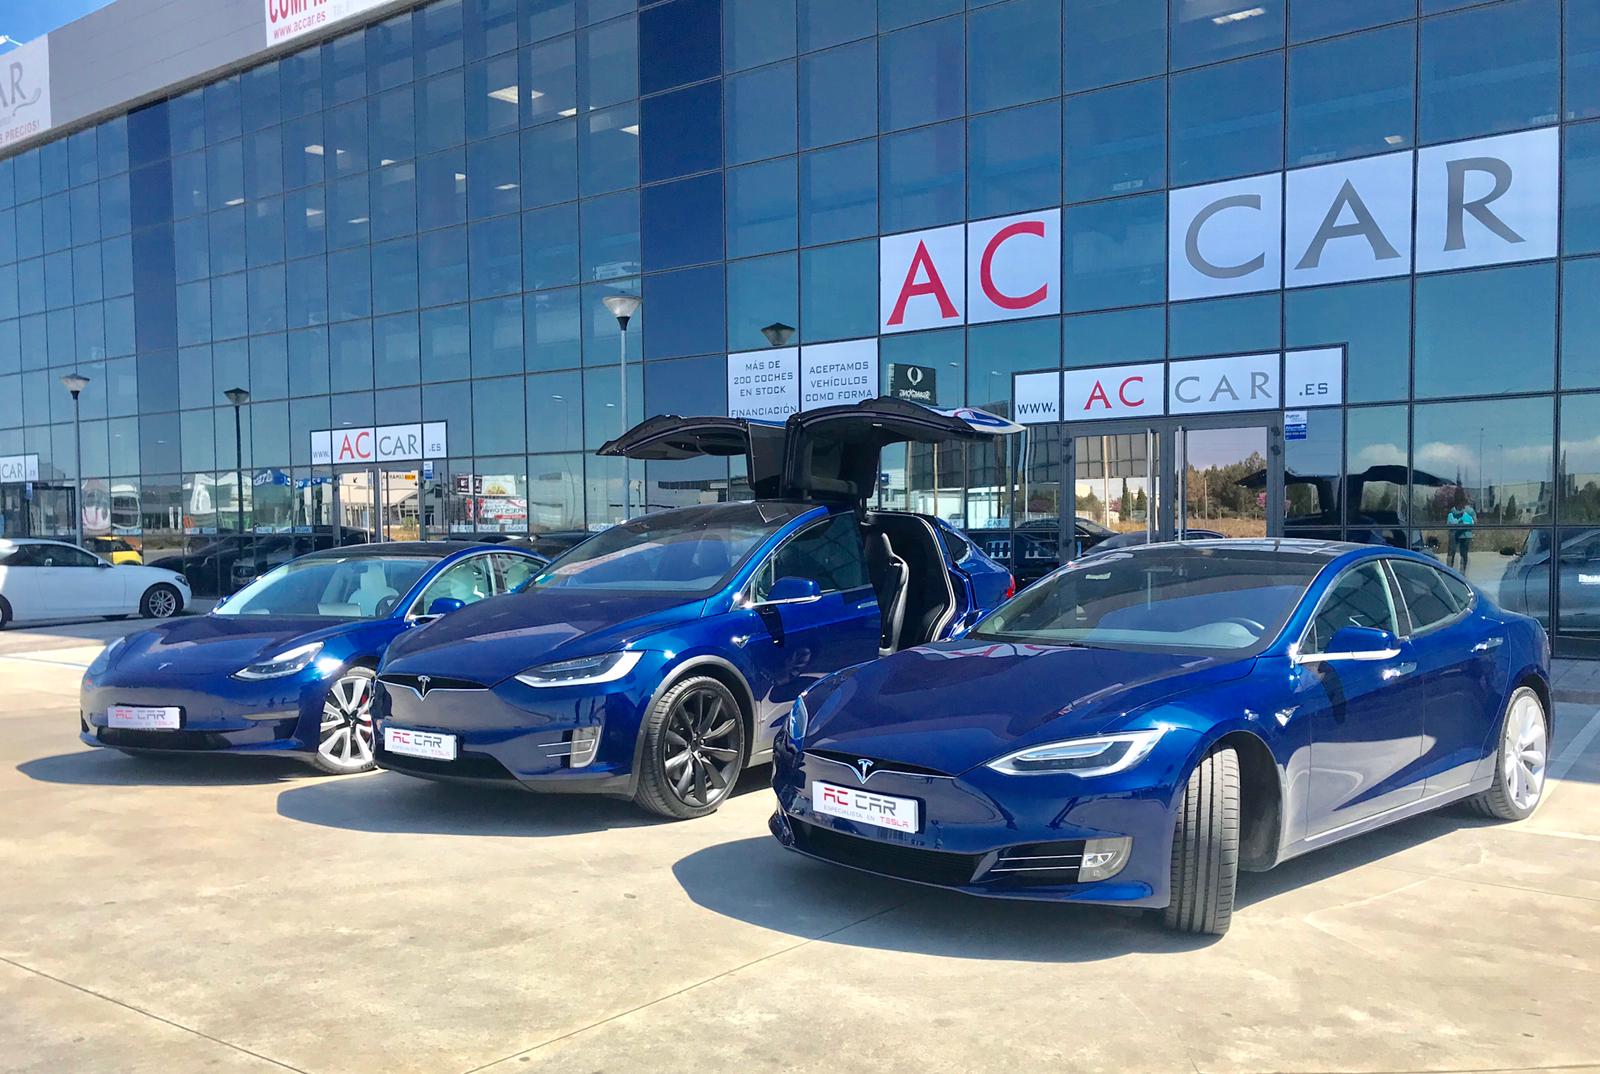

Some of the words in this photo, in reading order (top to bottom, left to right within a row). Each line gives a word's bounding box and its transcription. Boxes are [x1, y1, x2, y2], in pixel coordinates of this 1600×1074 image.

[273, 11, 327, 39] www.accar.es
[886, 221, 1048, 326] AC
[1184, 157, 1525, 279] CAR
[745, 360, 765, 371] MÁS
[768, 360, 781, 369] DE
[809, 361, 869, 375] ACEPTAMOS
[733, 375, 751, 385] 200
[754, 372, 793, 383] COCHES
[810, 375, 868, 388] VEHÍCULOS
[740, 388, 752, 397] EN
[755, 385, 786, 396] STOCK
[805, 392, 834, 402] COMO
[838, 389, 873, 400] FORMA
[1018, 402, 1056, 415] www.
[1083, 376, 1145, 411] AC
[1174, 371, 1273, 404] CAR
[1299, 382, 1328, 396] .ES
[731, 403, 797, 417] FINANCIACIÓN
[338, 431, 371, 460] AC
[379, 434, 419, 456] CAR
[1, 463, 23, 479] CAR
[137, 709, 166, 720] CAR
[392, 731, 410, 744] AC
[414, 734, 442, 748] CAR
[824, 787, 848, 806] AC
[855, 794, 896, 816] CAR
[823, 805, 864, 819] ESPECIALISTA
[866, 814, 875, 822] EN
[880, 816, 909, 828] TESLA
